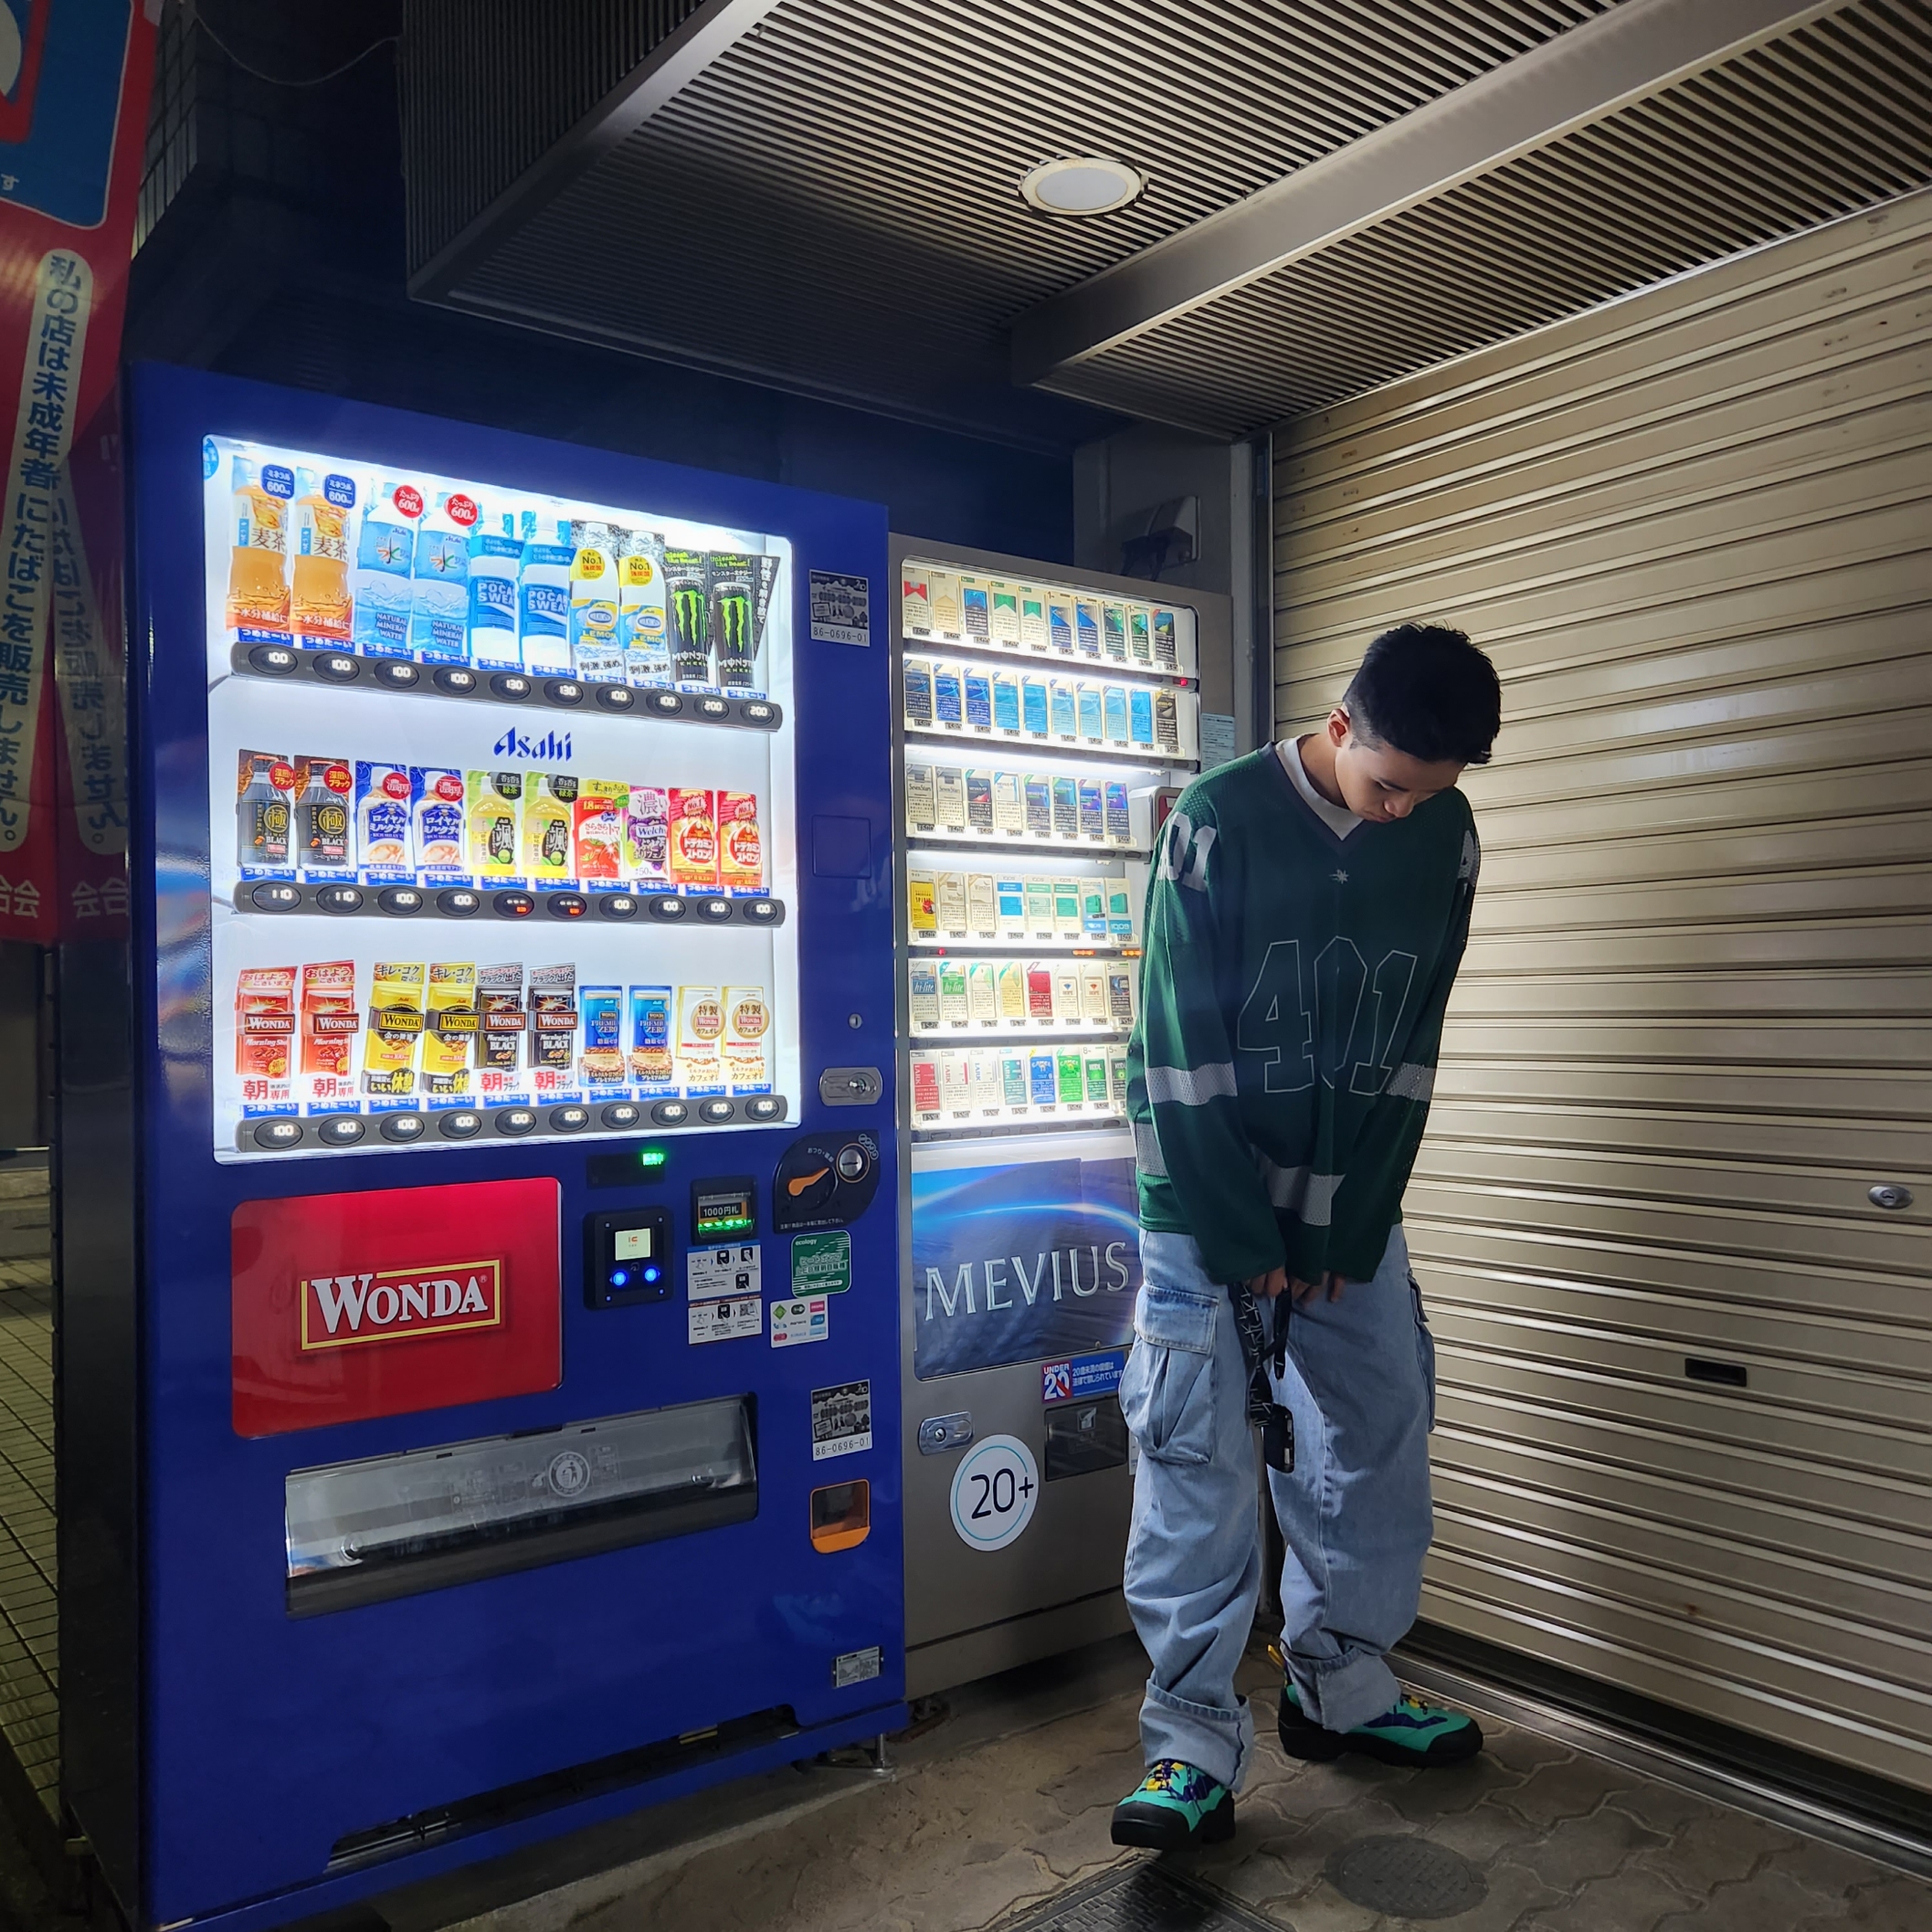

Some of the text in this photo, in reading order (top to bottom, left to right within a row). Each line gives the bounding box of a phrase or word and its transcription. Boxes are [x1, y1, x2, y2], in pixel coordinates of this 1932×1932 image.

[252, 528, 286, 554] 麦茶
[313, 535, 348, 559] 麦茶
[582, 556, 602, 565] No.1
[629, 563, 650, 571] No.1
[376, 612, 407, 626] NATURAL
[375, 621, 407, 633] MINERAL
[432, 620, 464, 632] NATURAL
[379, 629, 403, 640] WATER
[432, 628, 463, 640] MINERAL
[813, 627, 867, 642] 86-0696-01
[436, 637, 459, 648] WATER
[493, 726, 573, 762] Asahi
[502, 786, 517, 795] 緑茶
[637, 791, 668, 816] 濃い
[269, 809, 287, 828] 極
[322, 810, 343, 829] 極
[266, 836, 287, 844] BLACK
[322, 838, 344, 846] BLACK
[241, 972, 289, 981] おはよう
[305, 968, 351, 979] おはよう
[378, 966, 419, 976] キレ・コク
[434, 966, 472, 978] キレ・コク
[698, 1005, 718, 1016] 特製
[740, 1004, 762, 1015] 特製
[1238, 935, 1418, 1094] 401
[248, 1017, 291, 1029] WONDA
[319, 1017, 357, 1029] WONDA
[384, 1014, 419, 1028] WONDA
[444, 1015, 476, 1028] WONDA
[489, 1015, 522, 1026] WONDA
[539, 1014, 575, 1026] WONDA
[245, 1038, 276, 1046] Morning
[313, 1038, 342, 1046] Morning
[490, 1041, 515, 1050] BLACK
[543, 1040, 568, 1049] BLACK
[480, 1072, 502, 1092] 朝
[534, 1072, 555, 1090] 朝
[731, 1072, 764, 1081] カフェオレ
[243, 1080, 269, 1101] 朝
[312, 1078, 336, 1098] 朝
[703, 1206, 739, 1217] 1000円札
[924, 1241, 1130, 1322] MEVIUS
[311, 1273, 488, 1334] WONDA
[1043, 1363, 1070, 1374] UNDER
[1044, 1370, 1070, 1399] 20
[816, 1437, 869, 1456] 86-0696-01
[970, 1468, 1034, 1520] 20+
